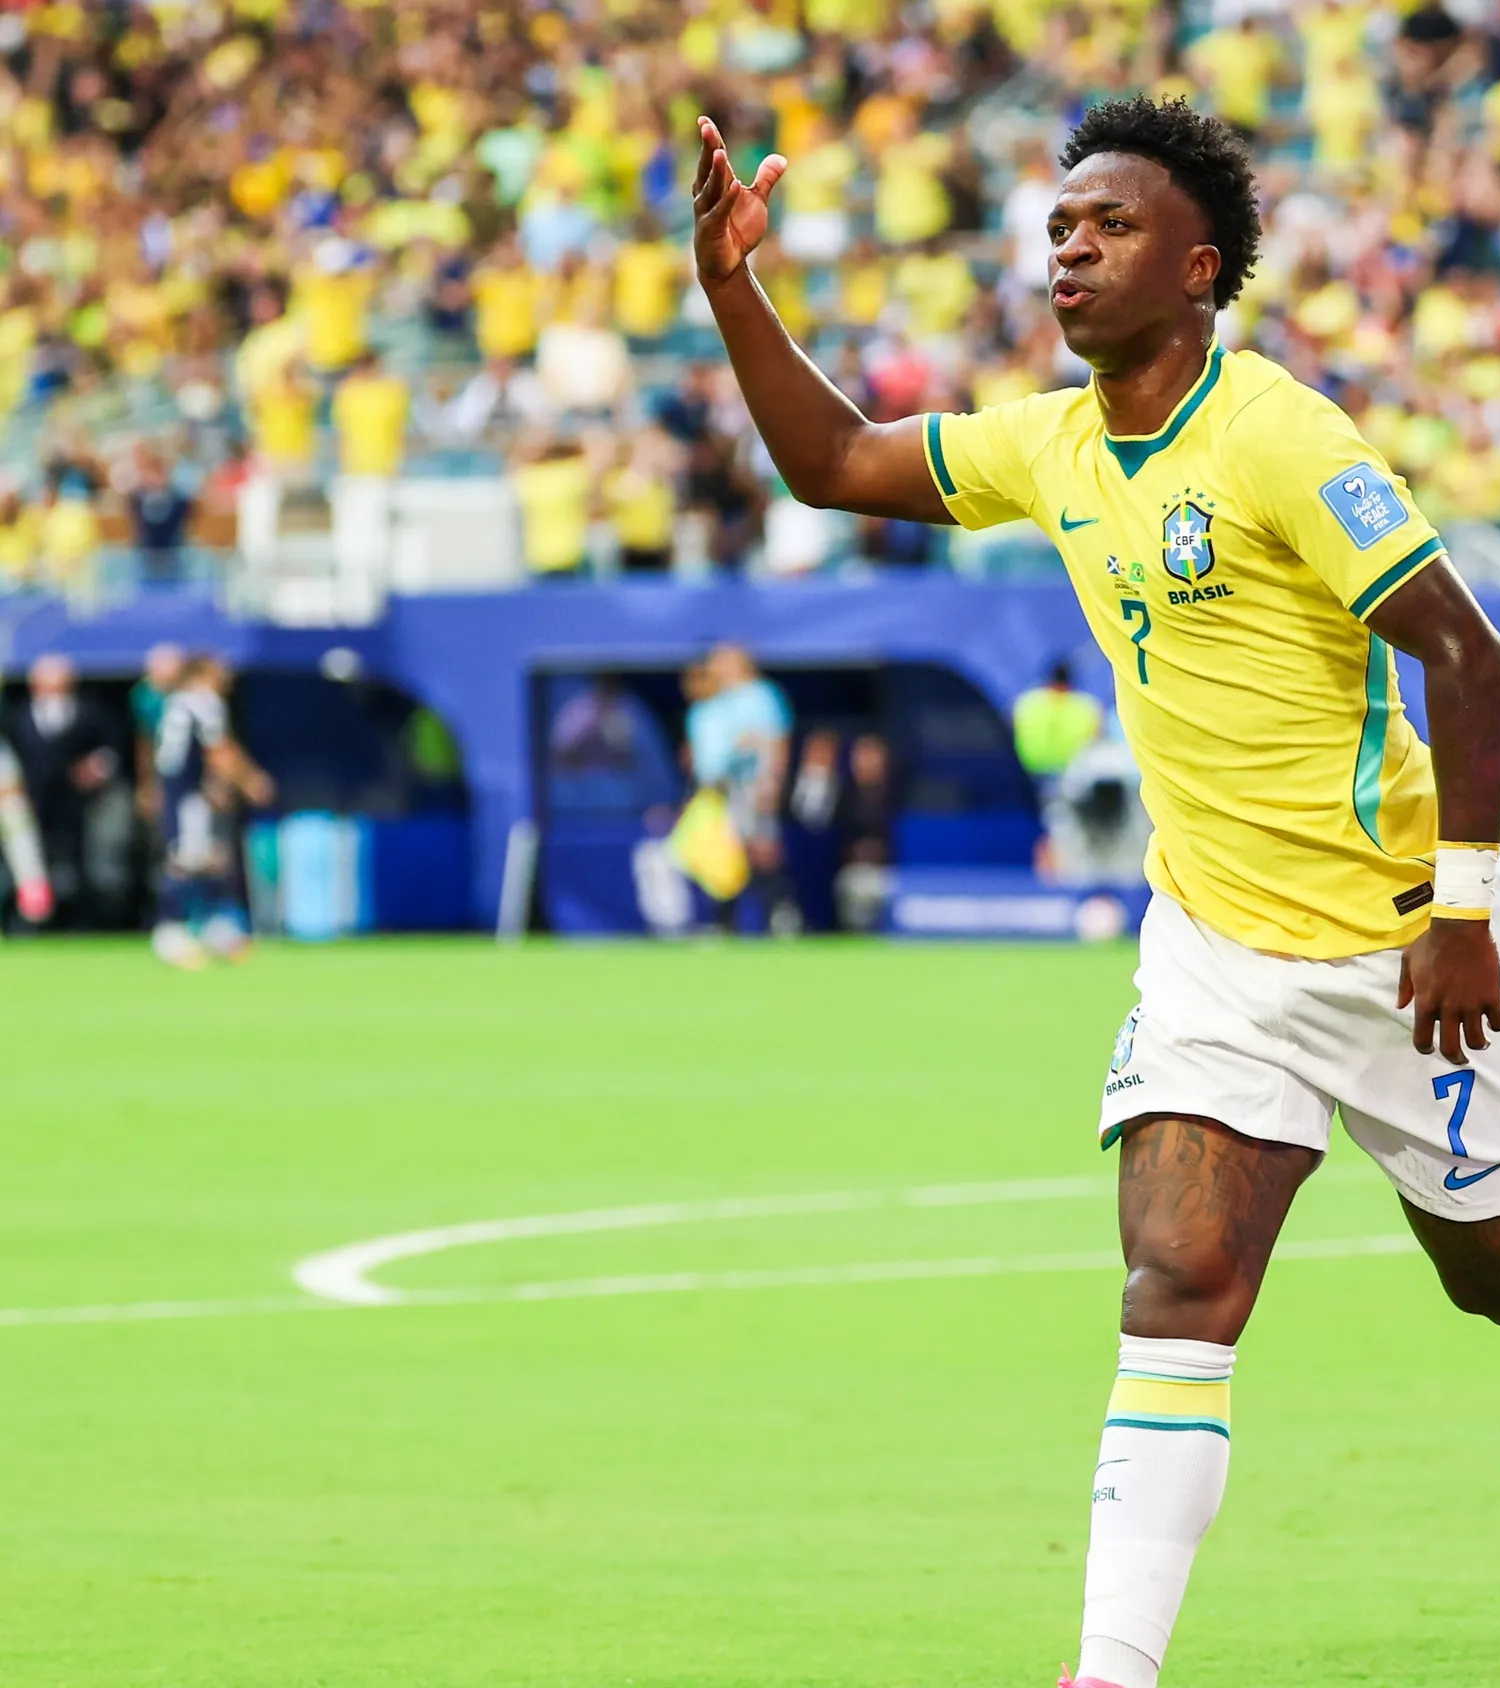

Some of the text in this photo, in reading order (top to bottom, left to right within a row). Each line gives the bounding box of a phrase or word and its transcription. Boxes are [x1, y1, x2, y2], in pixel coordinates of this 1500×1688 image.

[1360, 502, 1391, 528] PEACE
[1373, 518, 1390, 532] FIFA
[1175, 535, 1195, 546] CBF
[1167, 583, 1235, 605] BRASIL
[1120, 598, 1152, 686] 7
[1105, 1073, 1145, 1097] BRASIL
[1431, 1069, 1476, 1159] 7
[1093, 1486, 1122, 1504] ASIL
